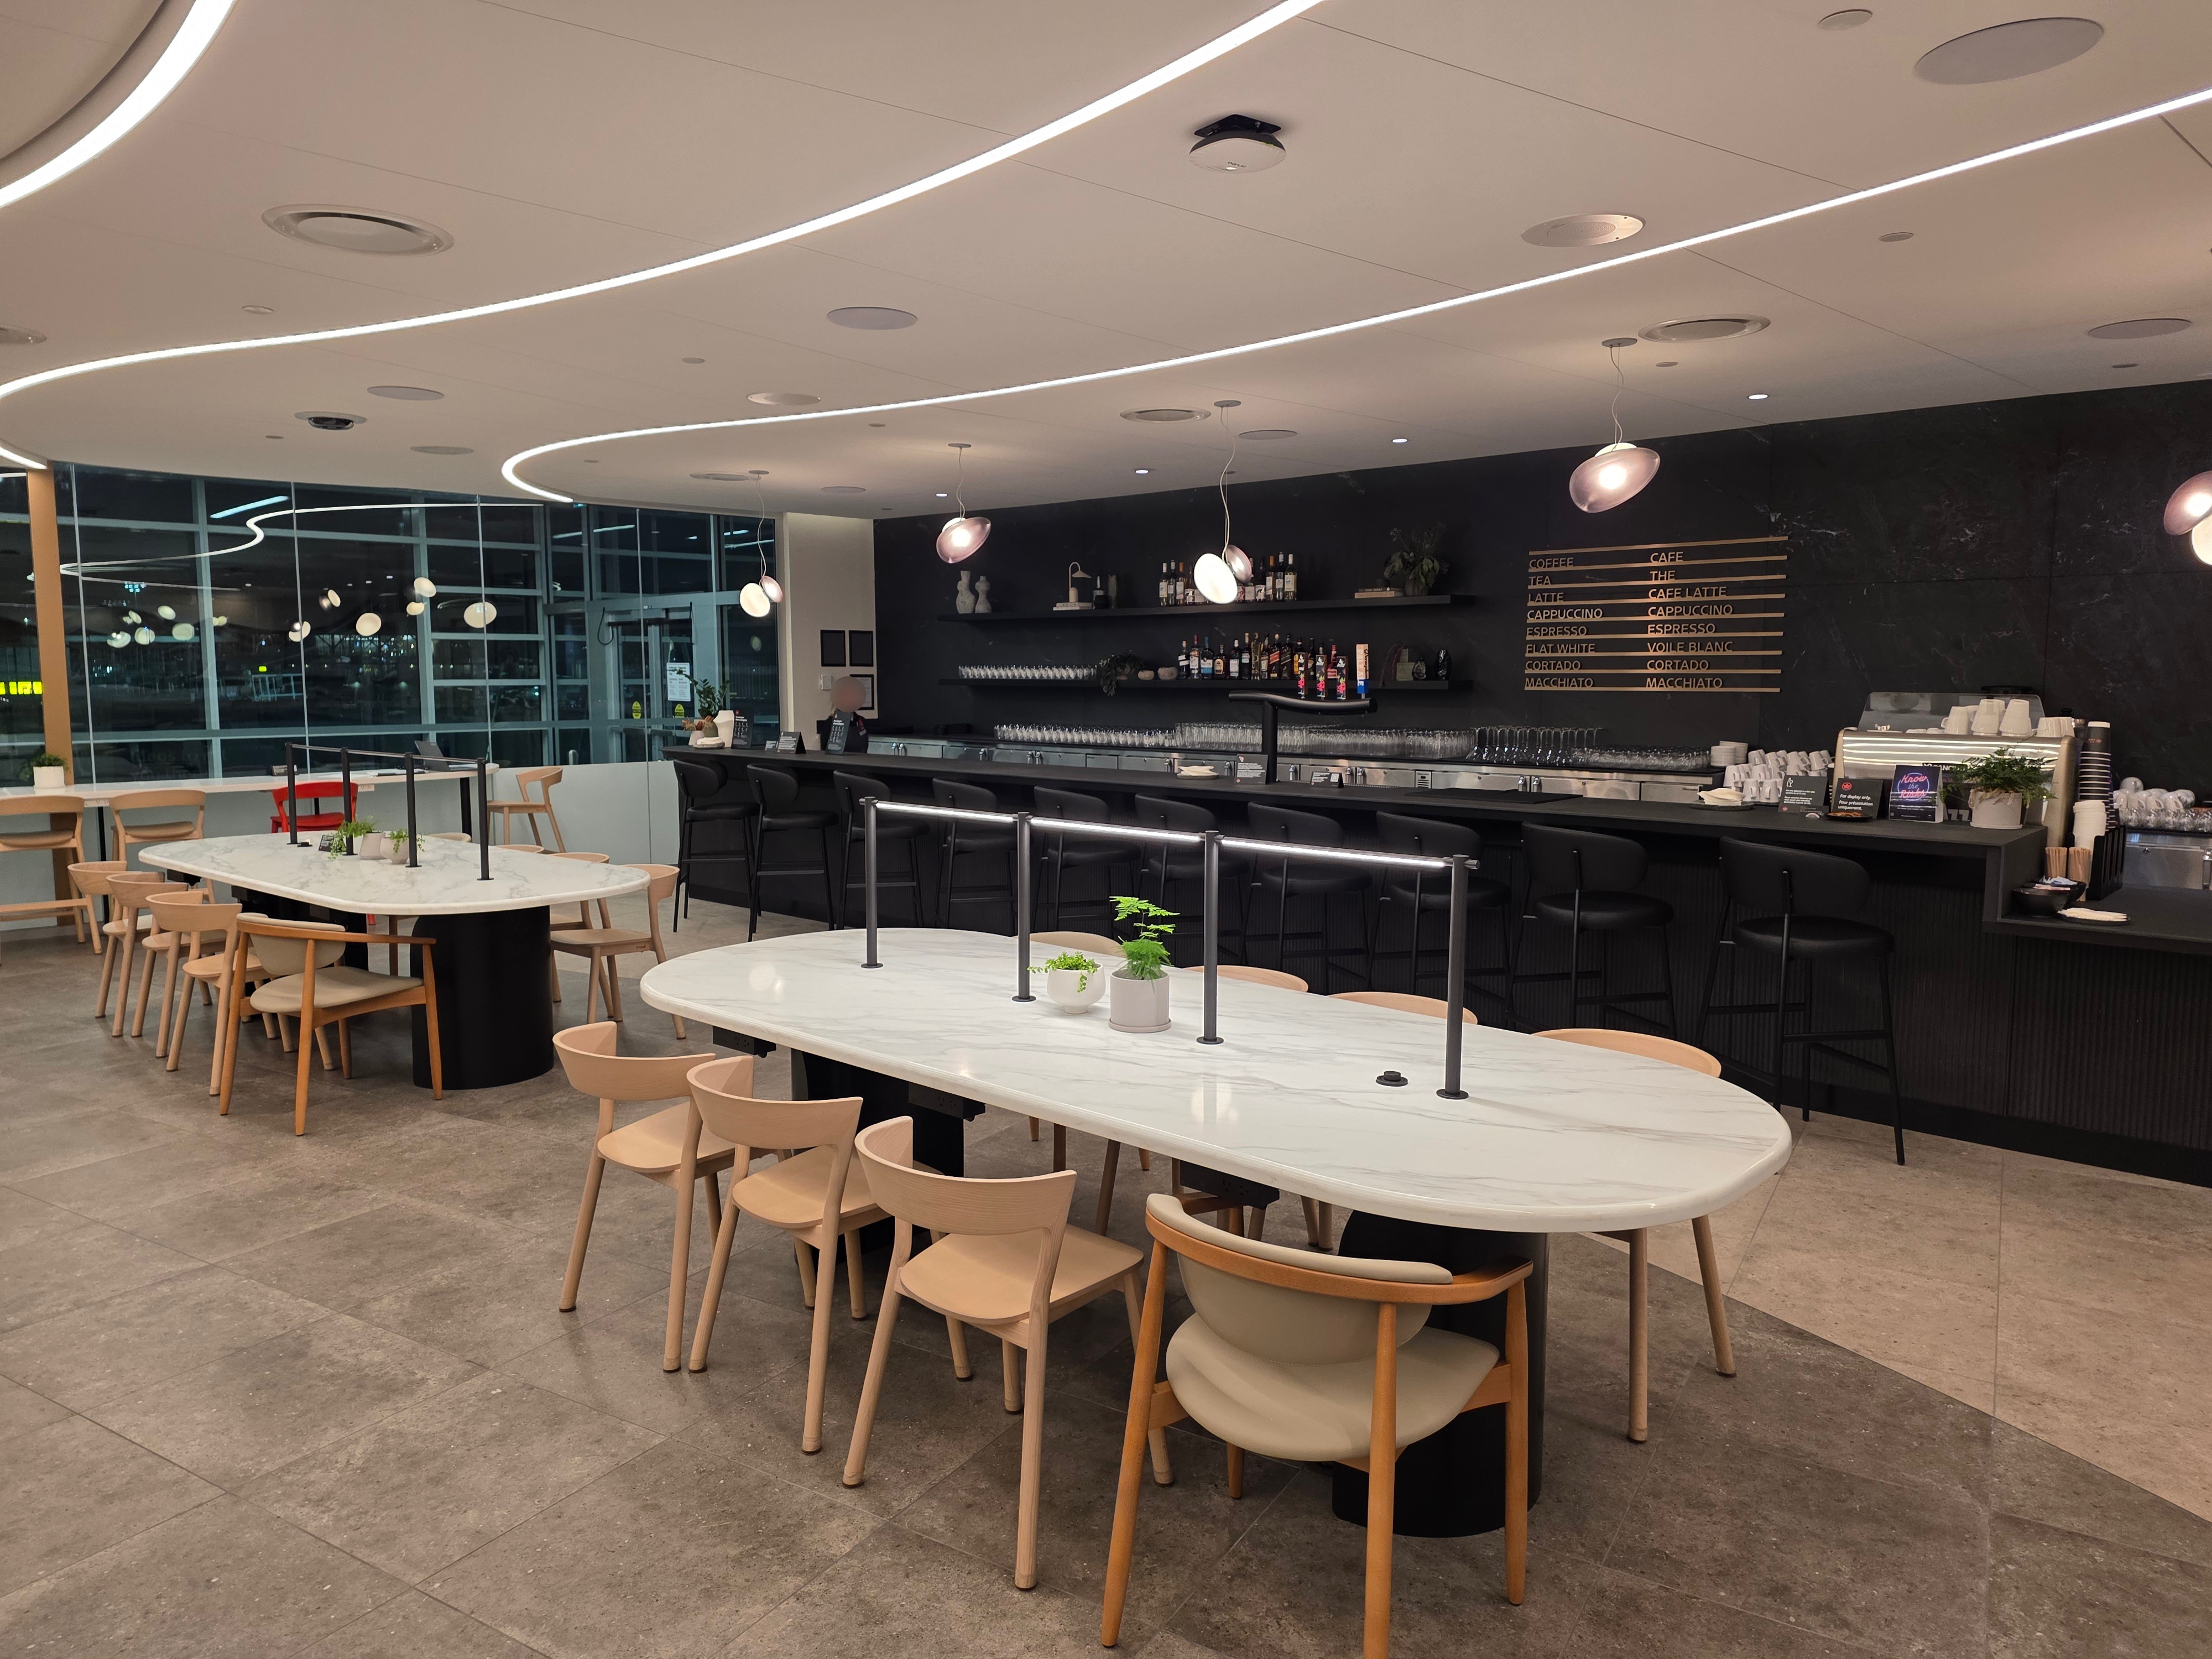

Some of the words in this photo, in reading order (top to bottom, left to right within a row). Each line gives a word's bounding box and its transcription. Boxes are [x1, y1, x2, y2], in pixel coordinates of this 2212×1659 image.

[1529, 557, 1574, 568] COFFEE
[1650, 551, 1684, 563] CAFE
[1528, 576, 1551, 586] TEA
[1650, 570, 1676, 581] THE
[1528, 592, 1564, 603] LATTE
[1648, 588, 1682, 599] CAFE
[1686, 586, 1727, 598] LATTE
[1527, 608, 1603, 620] CAPPUCCINO
[1648, 604, 1733, 617] CAPPUCCINO
[1526, 626, 1587, 637] ESPRESSO
[1647, 623, 1716, 634] ESPRESSO
[1526, 644, 1554, 654] FLAT
[1557, 643, 1596, 654] WHITE
[1647, 641, 1685, 653] VOILE
[1688, 641, 1733, 653] BLANC
[1525, 660, 1581, 670] CORTADO
[1646, 660, 1709, 670] CORTADO
[1525, 677, 1594, 688] MACCHIATO
[1646, 677, 1723, 688] MACCHIATO
[1901, 775, 1928, 784] Know
[1900, 788, 1927, 798] Risks
